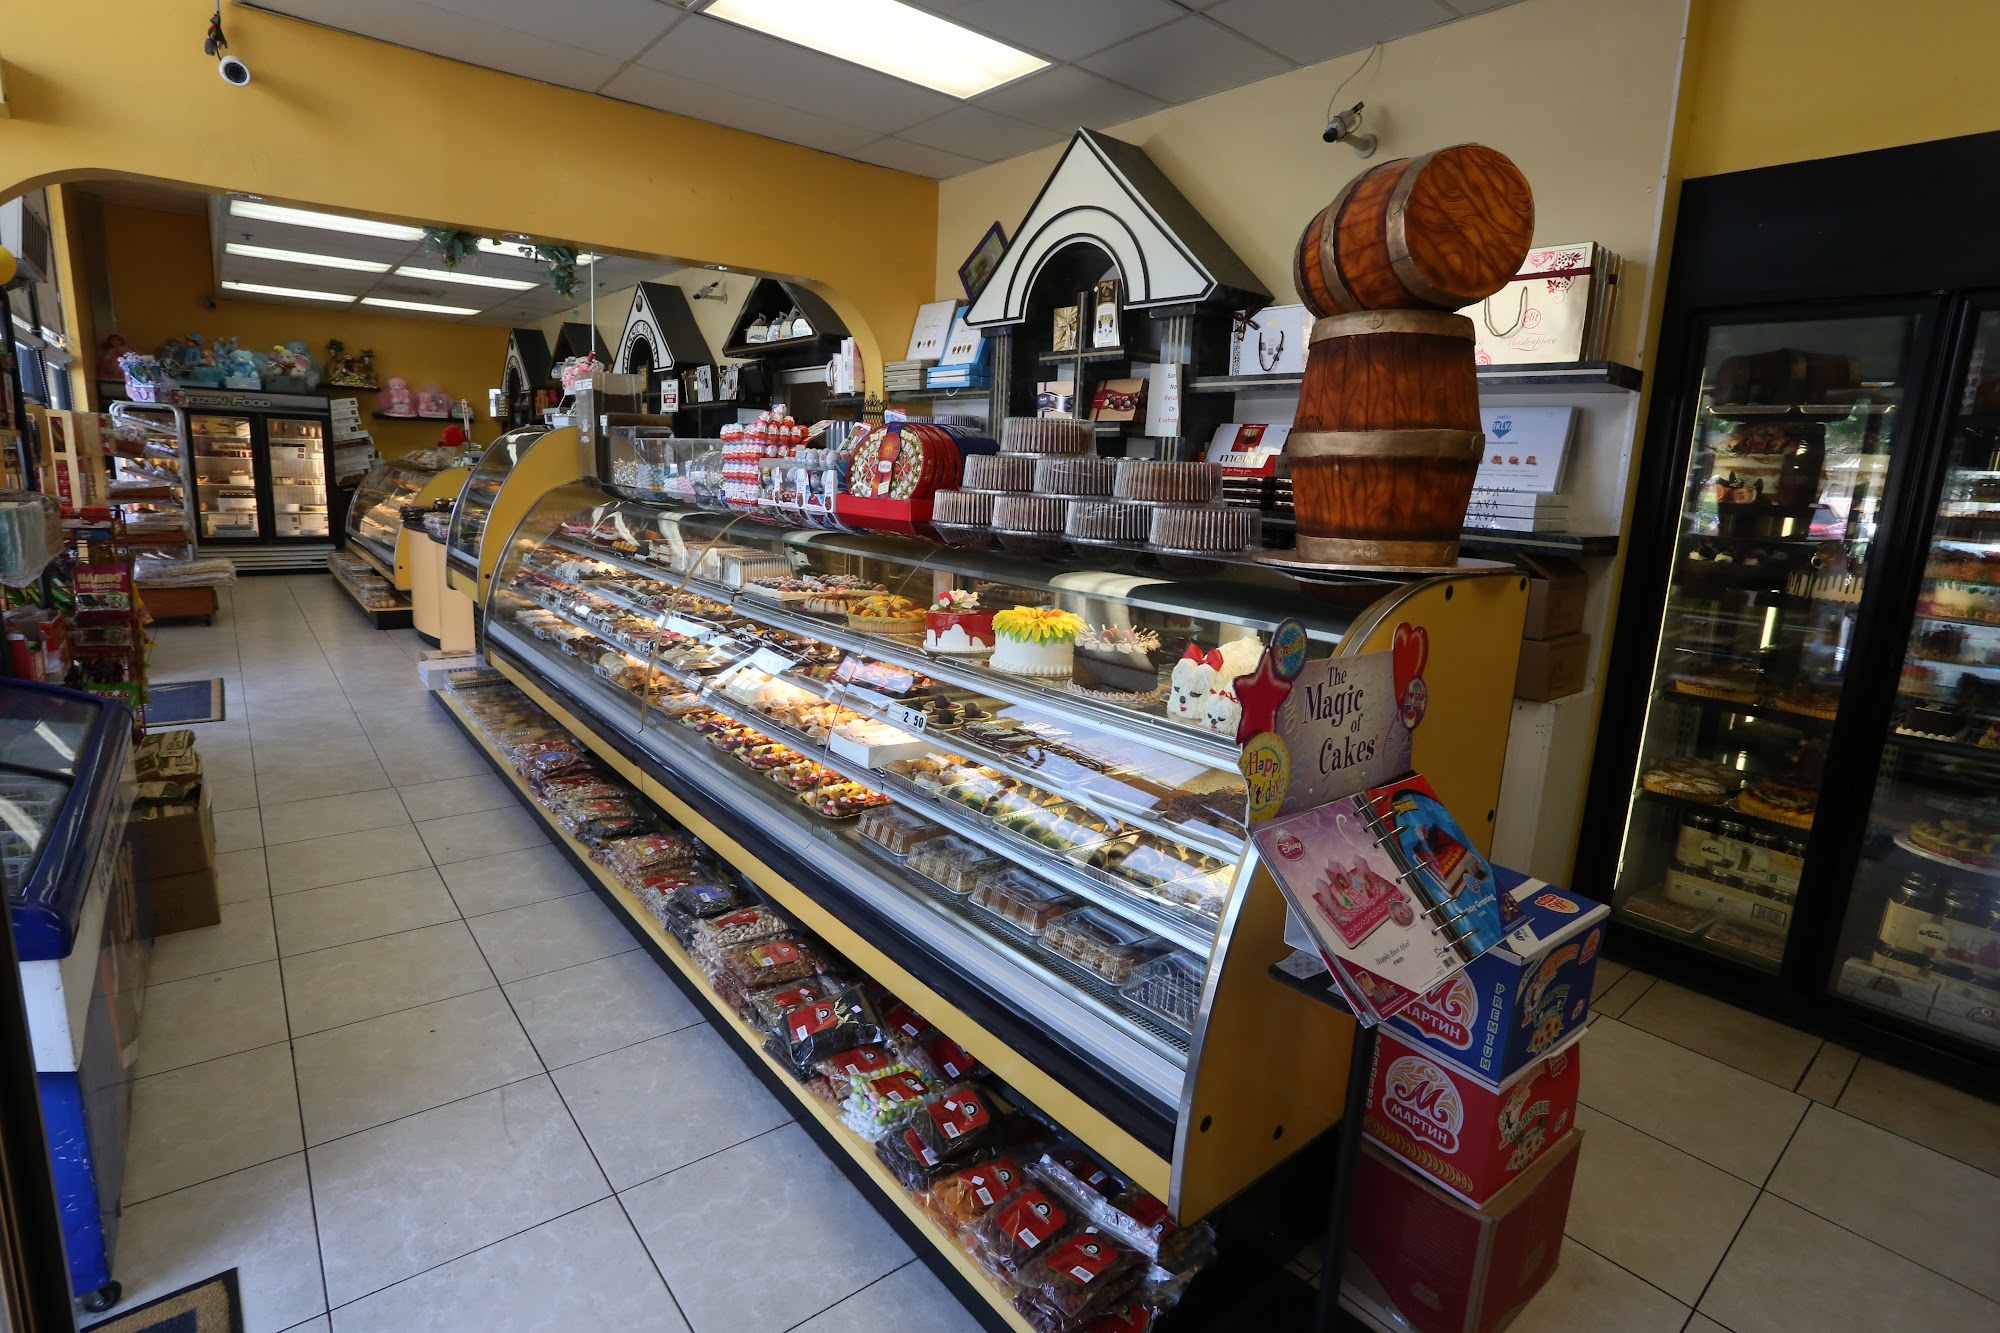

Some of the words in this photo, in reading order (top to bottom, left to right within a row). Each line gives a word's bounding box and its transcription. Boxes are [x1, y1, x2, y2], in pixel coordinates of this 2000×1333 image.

[1524, 311, 1540, 323] elit
[1502, 334, 1557, 349] Masterpiece
[1327, 666, 1347, 687] The
[1302, 683, 1364, 727] Magic
[1351, 713, 1363, 733] of
[1480, 983, 1505, 1071] PREMIUM
[1391, 1103, 1448, 1145] МАРТИН
